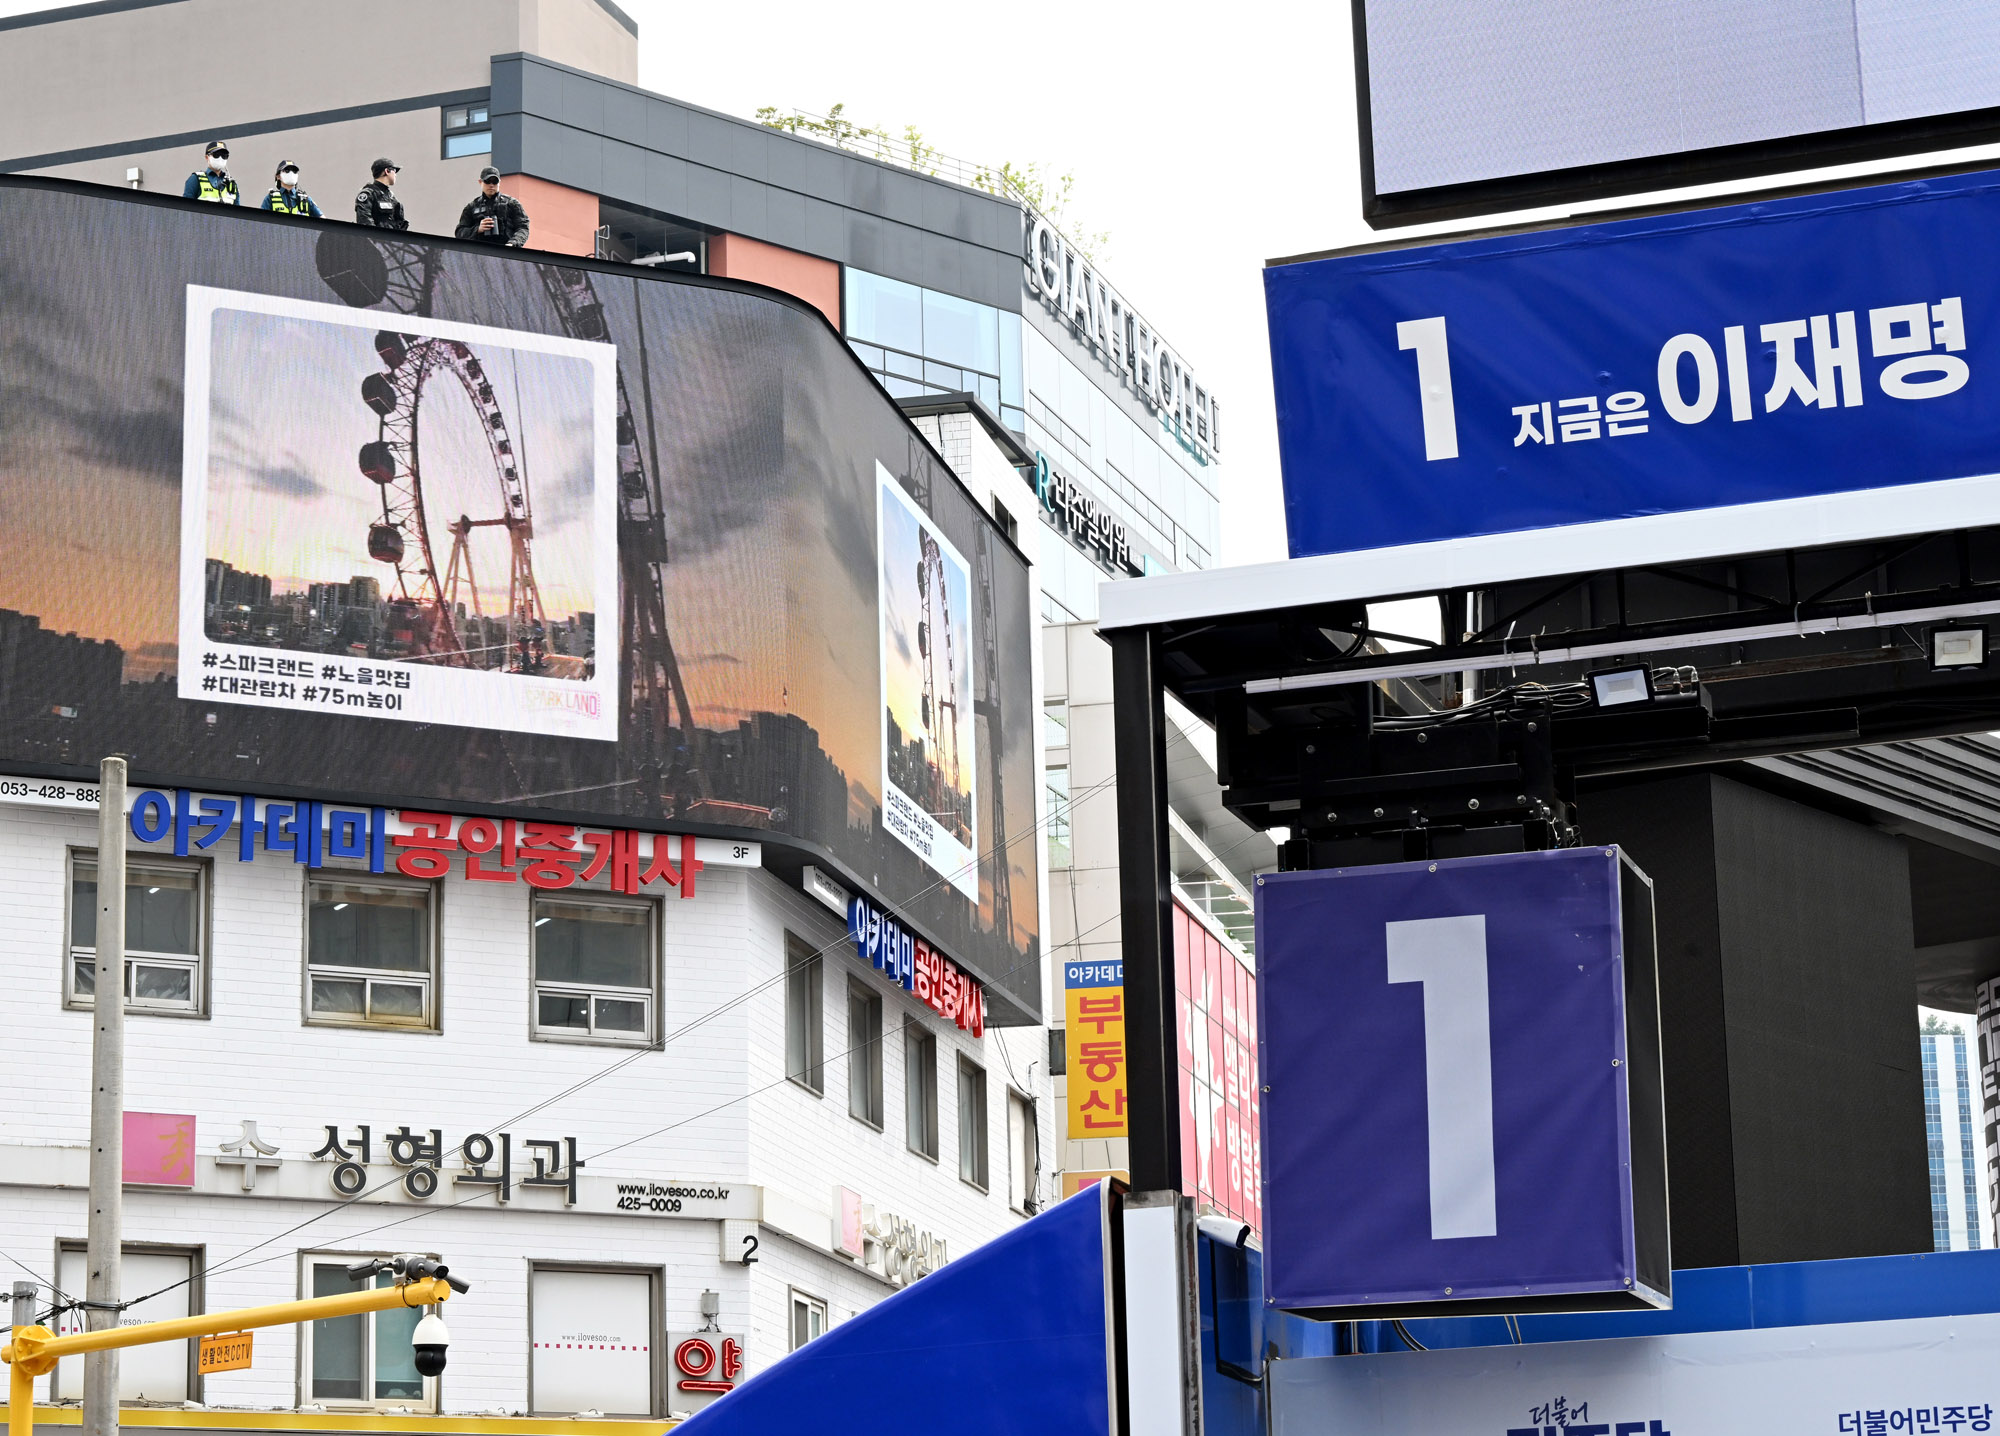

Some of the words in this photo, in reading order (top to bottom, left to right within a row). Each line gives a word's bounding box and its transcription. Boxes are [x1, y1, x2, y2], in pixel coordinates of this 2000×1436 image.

[1031, 217, 1131, 372] GIANT
[1396, 316, 1459, 461] 1
[1511, 391, 1649, 447] 지금은
[1657, 296, 1970, 424] 이재명
[202, 652, 315, 679] #스파크랜드
[321, 665, 411, 689] #노을맛집
[202, 675, 296, 700] #대관람차
[302, 685, 402, 711] #75m높이
[732, 845, 750, 860] 3F
[1079, 994, 1127, 1129] 부동산
[1386, 914, 1497, 1240] 1
[215, 1120, 282, 1190] 수
[309, 1124, 586, 1206] 성형외과
[617, 1183, 730, 1199] www.ilovesoo.co.kr
[617, 1196, 682, 1212] 425-0009
[742, 1235, 759, 1266] 2
[675, 1337, 743, 1394] 약
[1529, 1395, 1589, 1428] 더불어
[1838, 1403, 1994, 1436] 더불어민주당
